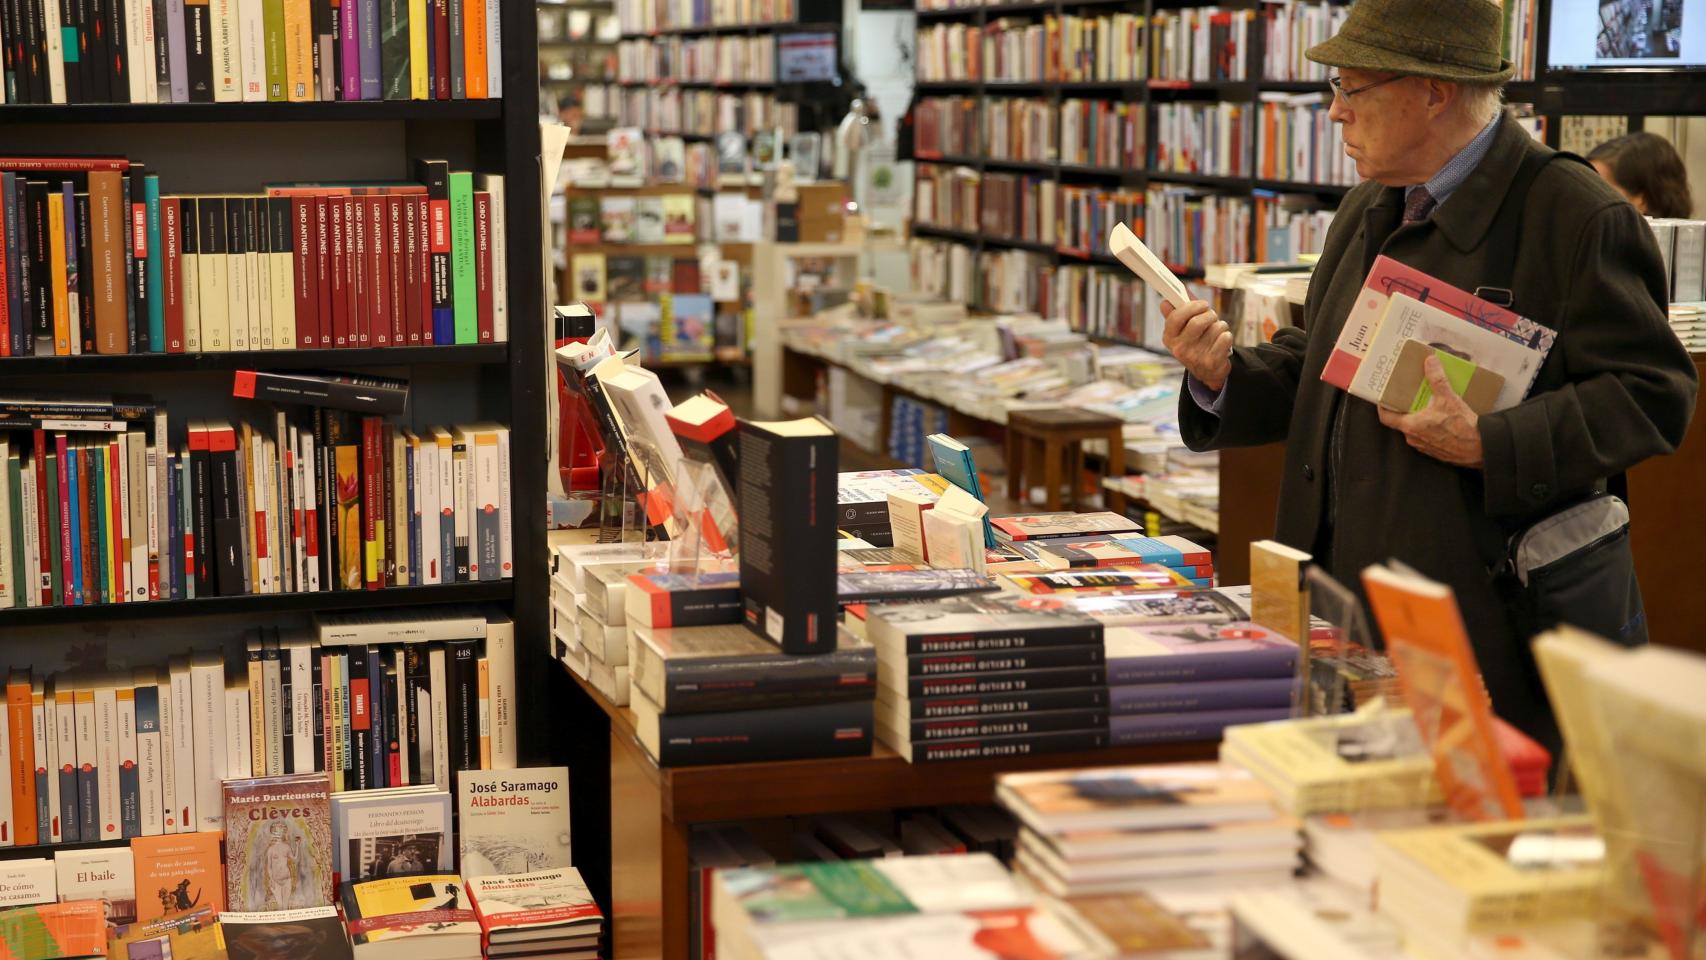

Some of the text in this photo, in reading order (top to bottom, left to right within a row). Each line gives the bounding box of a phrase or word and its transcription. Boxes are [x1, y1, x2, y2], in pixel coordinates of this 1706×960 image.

[223, 47, 231, 74] ALMEIDA
[102, 196, 110, 219] Cuentos
[135, 211, 145, 250] LOBO ANTUNES
[406, 202, 415, 253] LOBO ANTUNES
[435, 207, 444, 246] LOBO ANTUNES
[168, 226, 176, 258] ANTUNES
[300, 223, 308, 255] ANTUNES
[319, 223, 327, 255] ANTUNES
[104, 250, 112, 272] CLARICE
[105, 273, 113, 303] LISPECTOR
[1348, 325, 1368, 352] Juan
[1368, 354, 1388, 390] ARTURO
[62, 529, 70, 561] Masticando
[456, 649, 471, 657] 448
[922, 638, 1025, 652] EL EXILIO IMPOSIBLE
[923, 659, 1026, 673] EL EXILIO IMPOSIBLE
[923, 680, 1026, 695] EL EXILIO IMPOSIBLE
[356, 693, 364, 715] TAVARES
[925, 702, 1028, 716] EL EXILIO IMPOSIBLE
[925, 723, 1028, 738] EL EXILIO IMPOSIBLE
[145, 738, 154, 761] Portugal
[927, 744, 1030, 760] EL EXILIO IMPOSIBLE
[469, 780, 557, 793] José Saramago
[231, 791, 328, 804] Marie Darrieussecq
[470, 794, 529, 808] Alabardas
[249, 807, 311, 821] Clèves
[77, 870, 116, 883] El baile
[508, 873, 562, 883] Saramago
[13, 883, 34, 891] cómo
[481, 882, 535, 891] Alabardas
